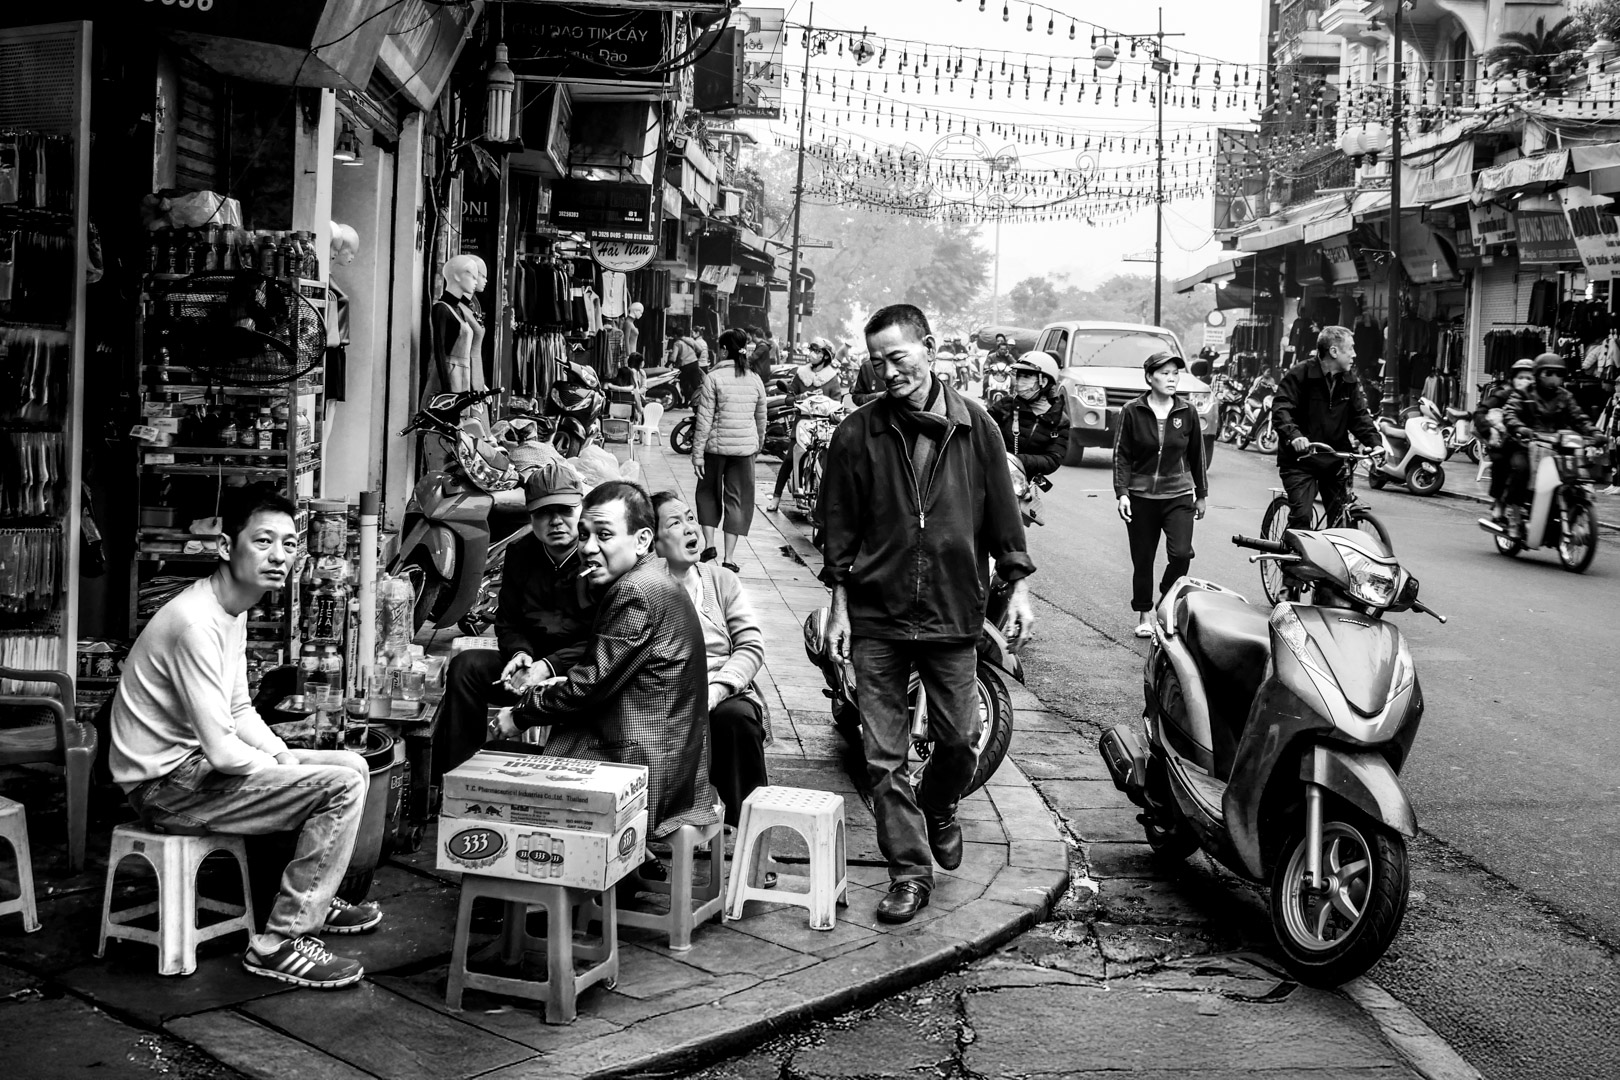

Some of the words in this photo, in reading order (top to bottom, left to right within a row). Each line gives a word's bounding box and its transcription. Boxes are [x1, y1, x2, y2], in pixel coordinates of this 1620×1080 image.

[587, 26, 613, 41] TIN
[617, 26, 649, 44] CẬY
[624, 242, 650, 257] Nam
[326, 600, 334, 627] TEA
[518, 790, 543, 799] Industries
[566, 795, 588, 804] Thailand
[461, 832, 489, 855] 333
[534, 851, 546, 861] 333
